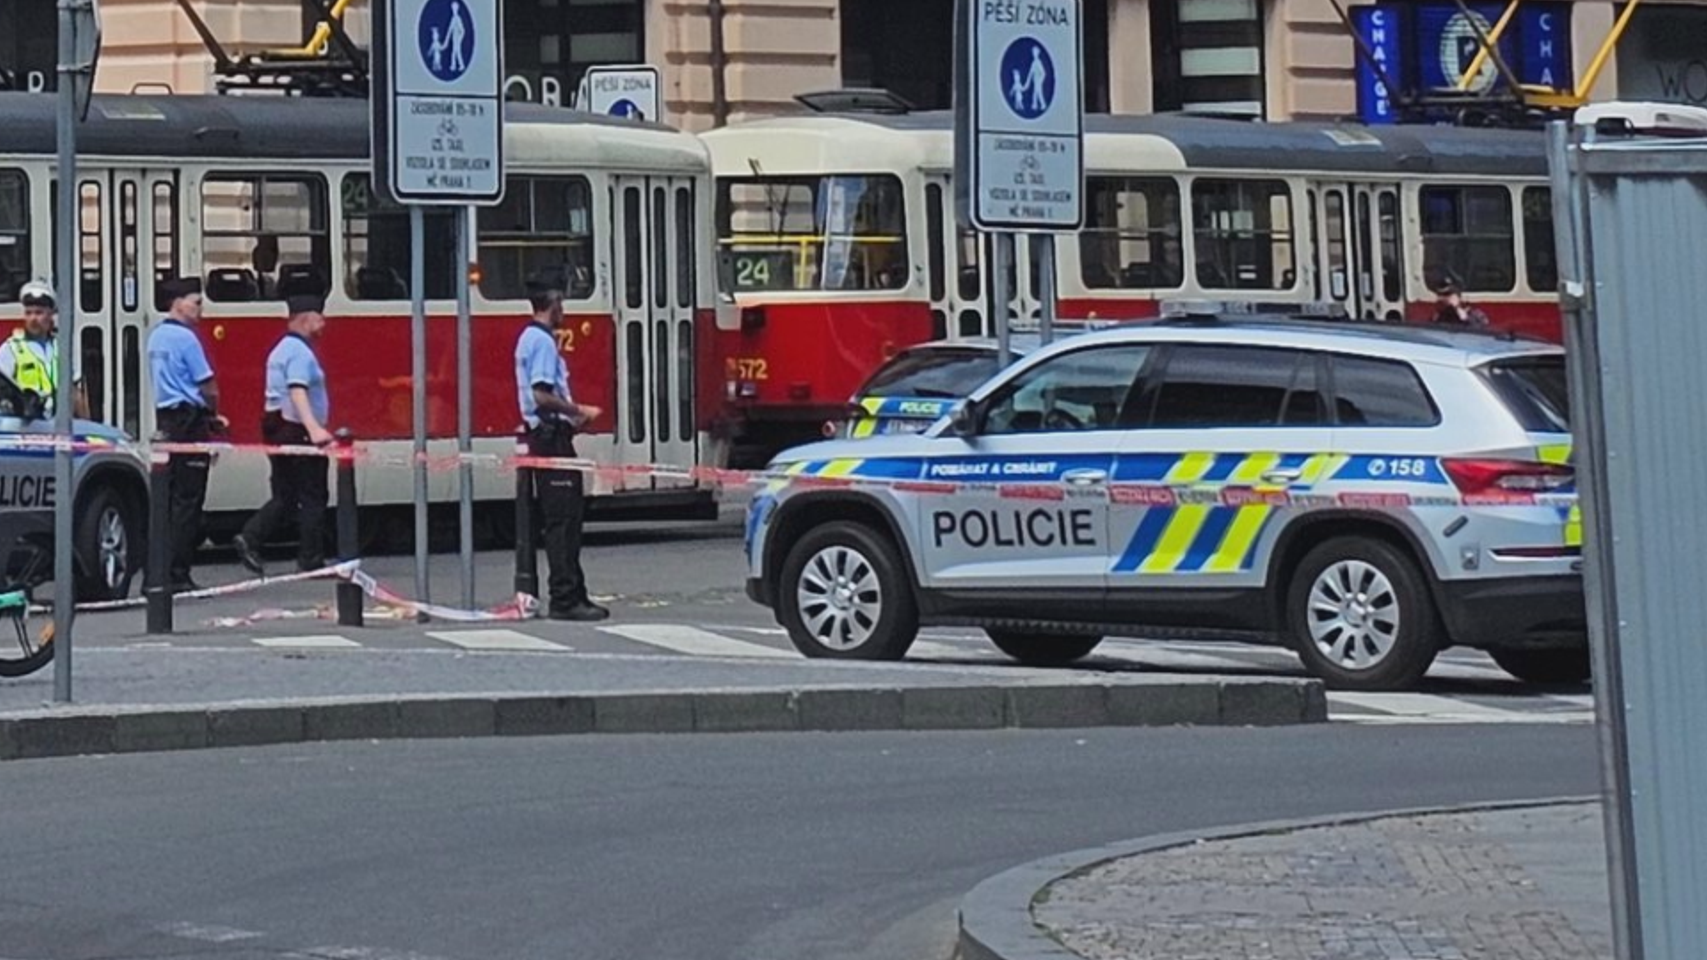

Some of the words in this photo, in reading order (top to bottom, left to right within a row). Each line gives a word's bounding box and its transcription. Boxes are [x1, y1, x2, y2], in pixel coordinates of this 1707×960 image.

[984, 0, 1020, 24] PĚŠÍ
[1026, 1, 1069, 26] ZÓNA
[1371, 10, 1390, 115] CHAGE
[622, 76, 651, 91] ZÓNA
[736, 257, 769, 286] 24
[1389, 458, 1426, 476] 158
[933, 508, 1096, 548] POLICIE
